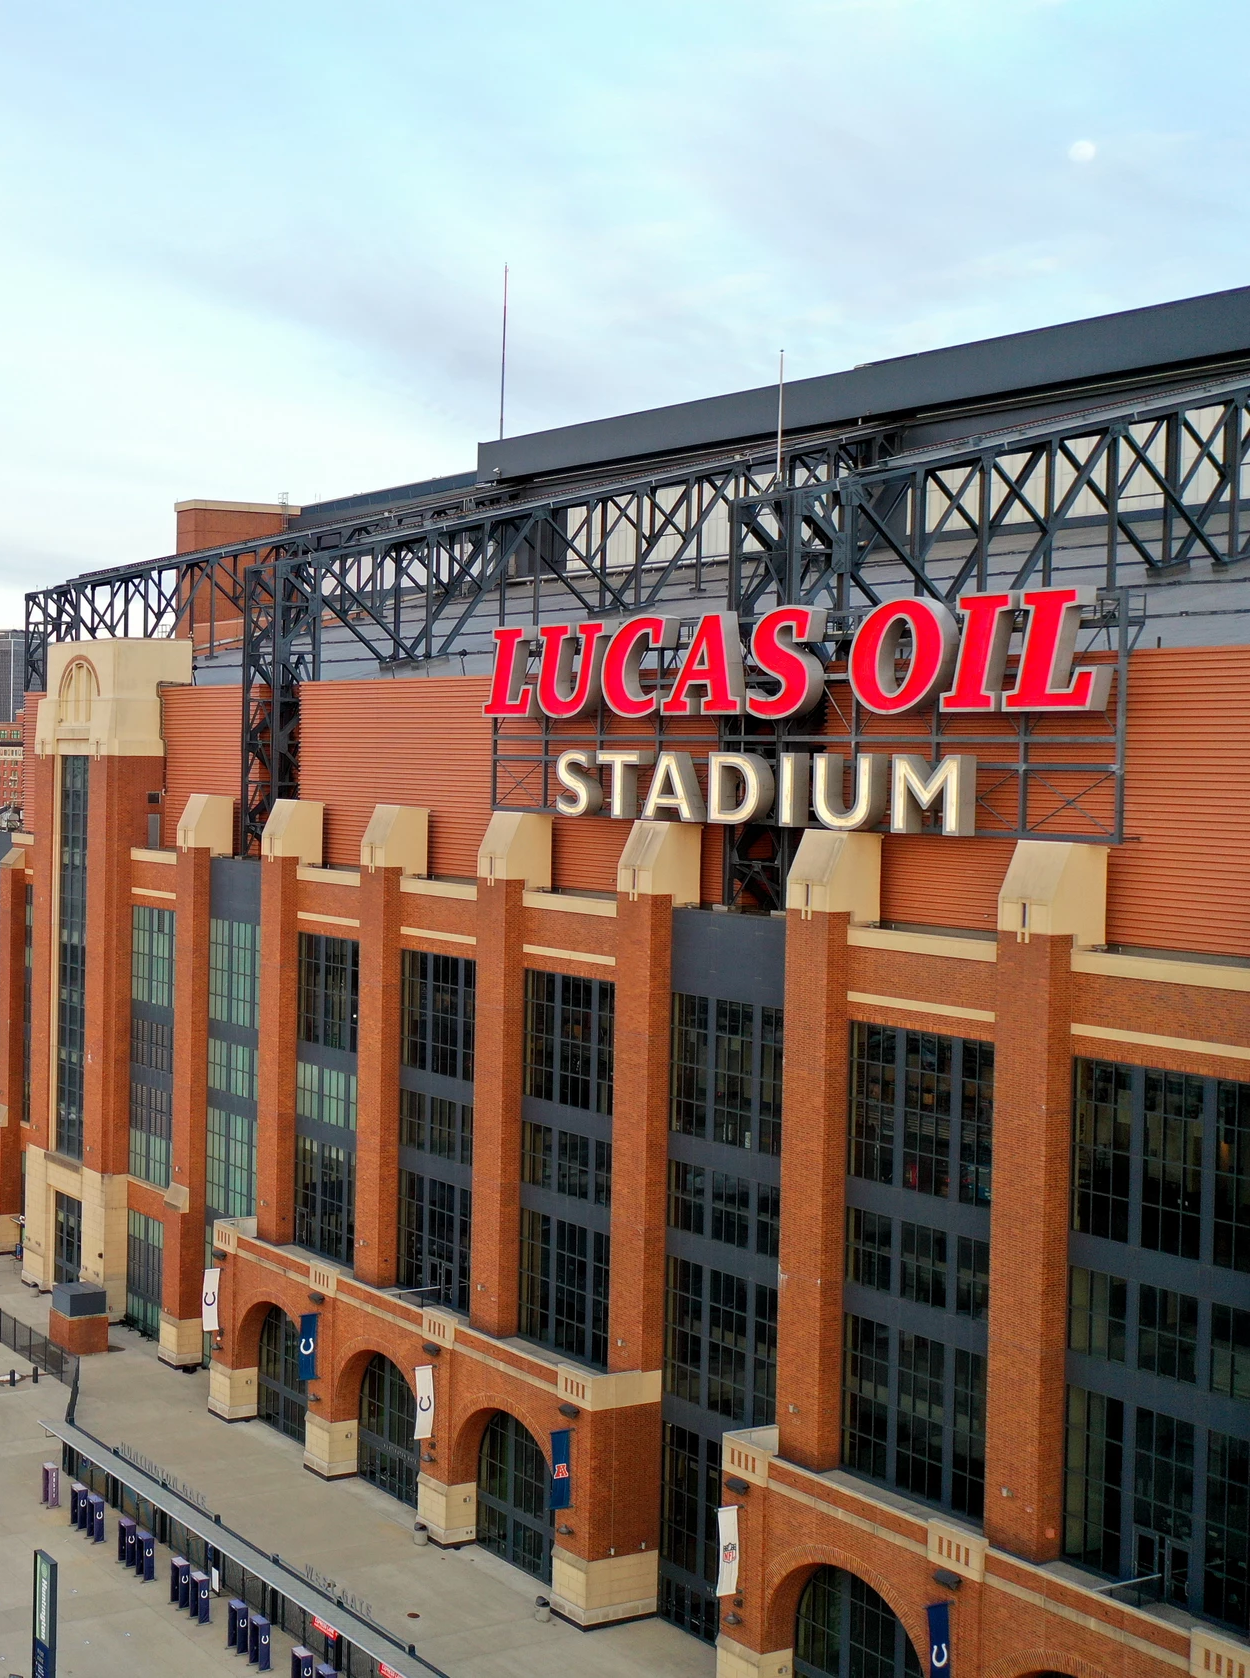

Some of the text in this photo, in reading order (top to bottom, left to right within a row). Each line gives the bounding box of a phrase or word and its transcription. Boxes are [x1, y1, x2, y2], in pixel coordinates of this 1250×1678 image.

[482, 585, 1114, 719] LUCAS OIL
[556, 750, 977, 836] STADIUM
[723, 1551, 736, 1561] NFL
[40, 1578, 48, 1641] Huntington
[342, 1587, 372, 1618] GATE
